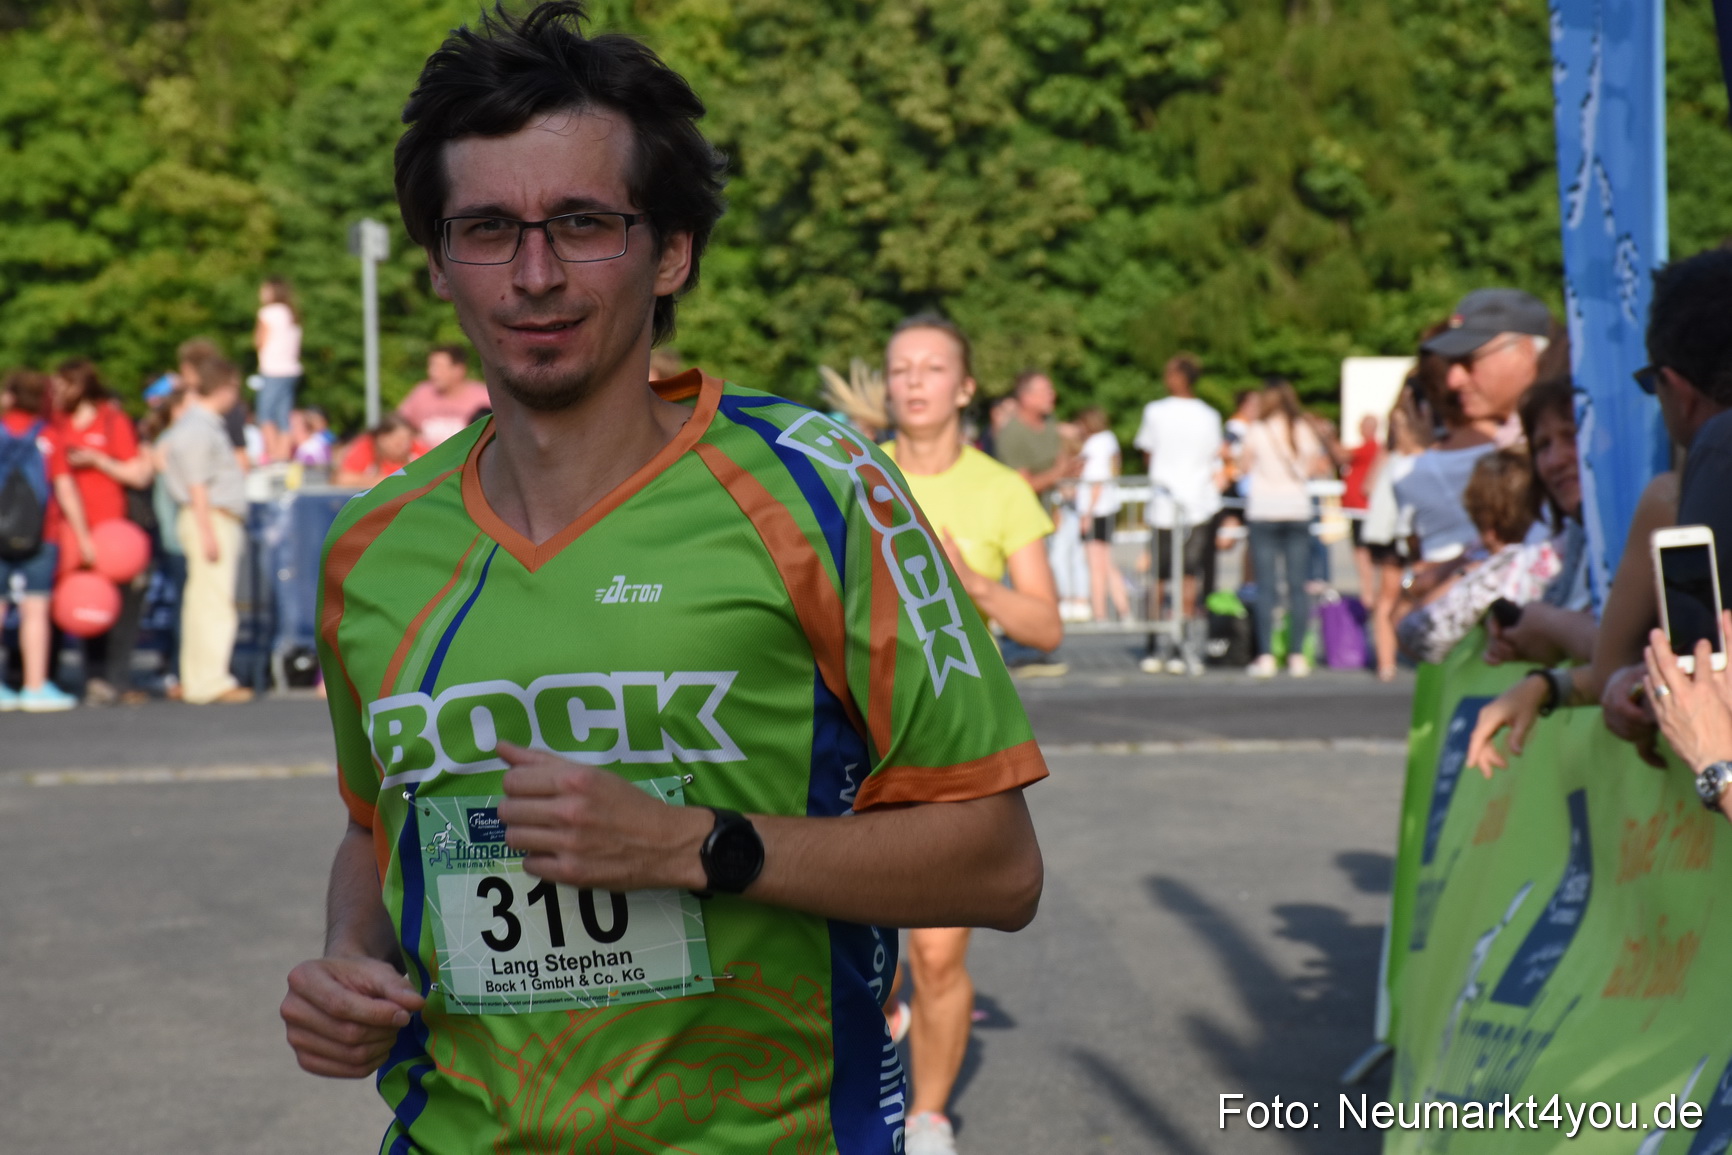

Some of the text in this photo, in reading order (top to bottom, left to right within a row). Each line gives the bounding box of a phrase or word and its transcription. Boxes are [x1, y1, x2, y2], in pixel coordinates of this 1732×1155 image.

[775, 410, 981, 699] BOCK
[368, 671, 747, 788] BOCK
[457, 860, 496, 869] neumarkt
[476, 876, 629, 953] 310
[485, 967, 645, 993] Bock 1 GmbH & Co. KG
[491, 950, 633, 978] Lang Stephan
